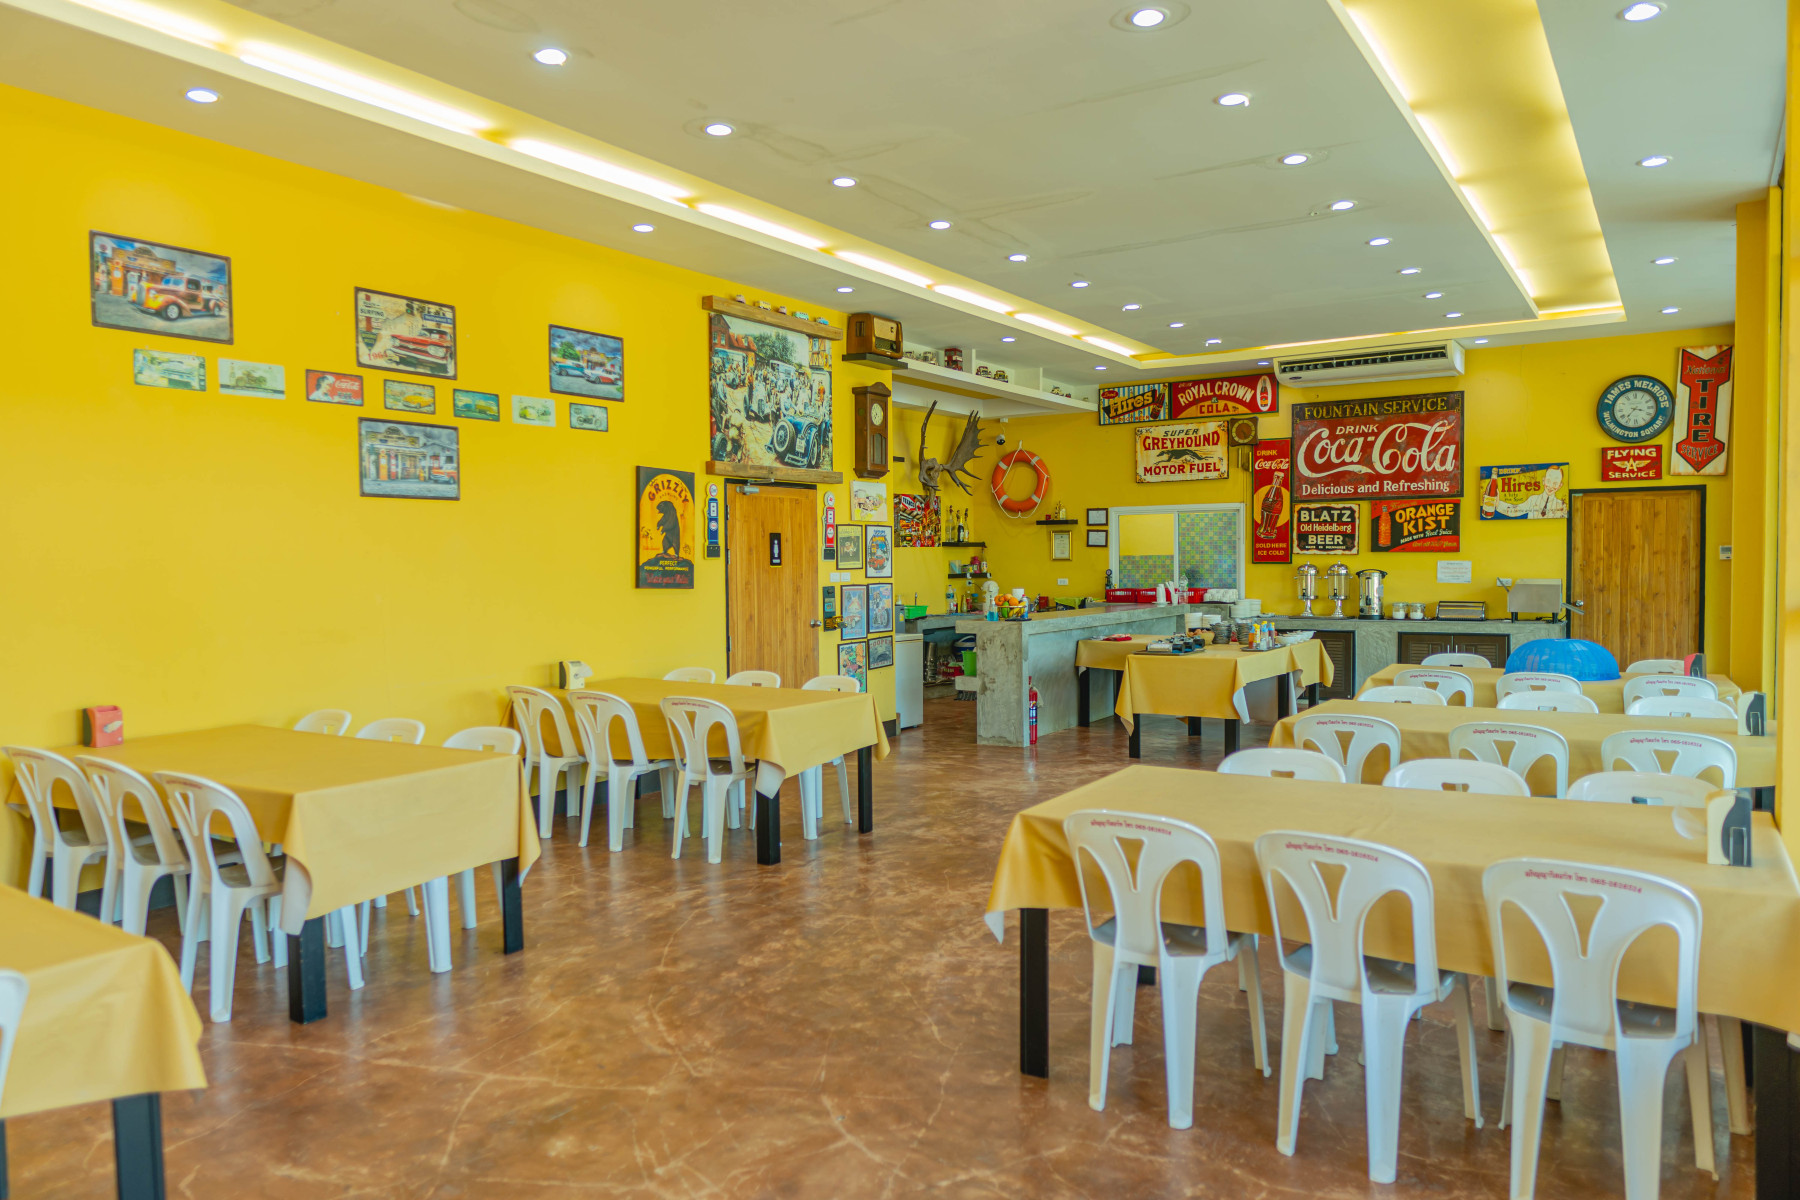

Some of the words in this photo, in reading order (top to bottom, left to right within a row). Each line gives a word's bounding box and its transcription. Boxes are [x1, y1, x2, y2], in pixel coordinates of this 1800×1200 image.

[1178, 382, 1214, 407] ROYAL
[1215, 381, 1255, 403] CROWN
[1604, 381, 1631, 404] JAMES
[1634, 380, 1669, 408] MELROSE
[1109, 391, 1153, 417] Hires
[1200, 403, 1230, 414] COLA
[1305, 402, 1379, 420] FOUNTAIN
[1384, 396, 1448, 414] SERVICE
[1691, 378, 1714, 443] TIRE
[1163, 428, 1200, 437] SUPER
[1336, 424, 1380, 435] DRINK
[1603, 411, 1639, 437] WILMINGTON
[1640, 415, 1665, 436] SQUARE
[1143, 430, 1220, 451] GREYHOUND
[1297, 419, 1457, 478] Coca-Cola
[1607, 448, 1657, 460] FLYING
[1680, 443, 1719, 460] SERVICE
[1143, 464, 1186, 476] MOTOR
[1189, 462, 1221, 474] FUEL
[1255, 458, 1289, 470] Coca-Cola
[1608, 470, 1656, 479] SERVICE
[648, 479, 689, 503] GRIZZLY
[1302, 483, 1355, 496] Delicious
[1358, 481, 1380, 493] and
[1383, 479, 1450, 493] Refreshing
[1501, 477, 1541, 492] Hires
[1300, 510, 1352, 522] BLATZ
[1395, 503, 1455, 523] ORANGE
[1300, 523, 1312, 532] Old
[1313, 523, 1352, 533] Heidelberg
[1403, 515, 1450, 536] KIST
[1308, 535, 1343, 544] BEER
